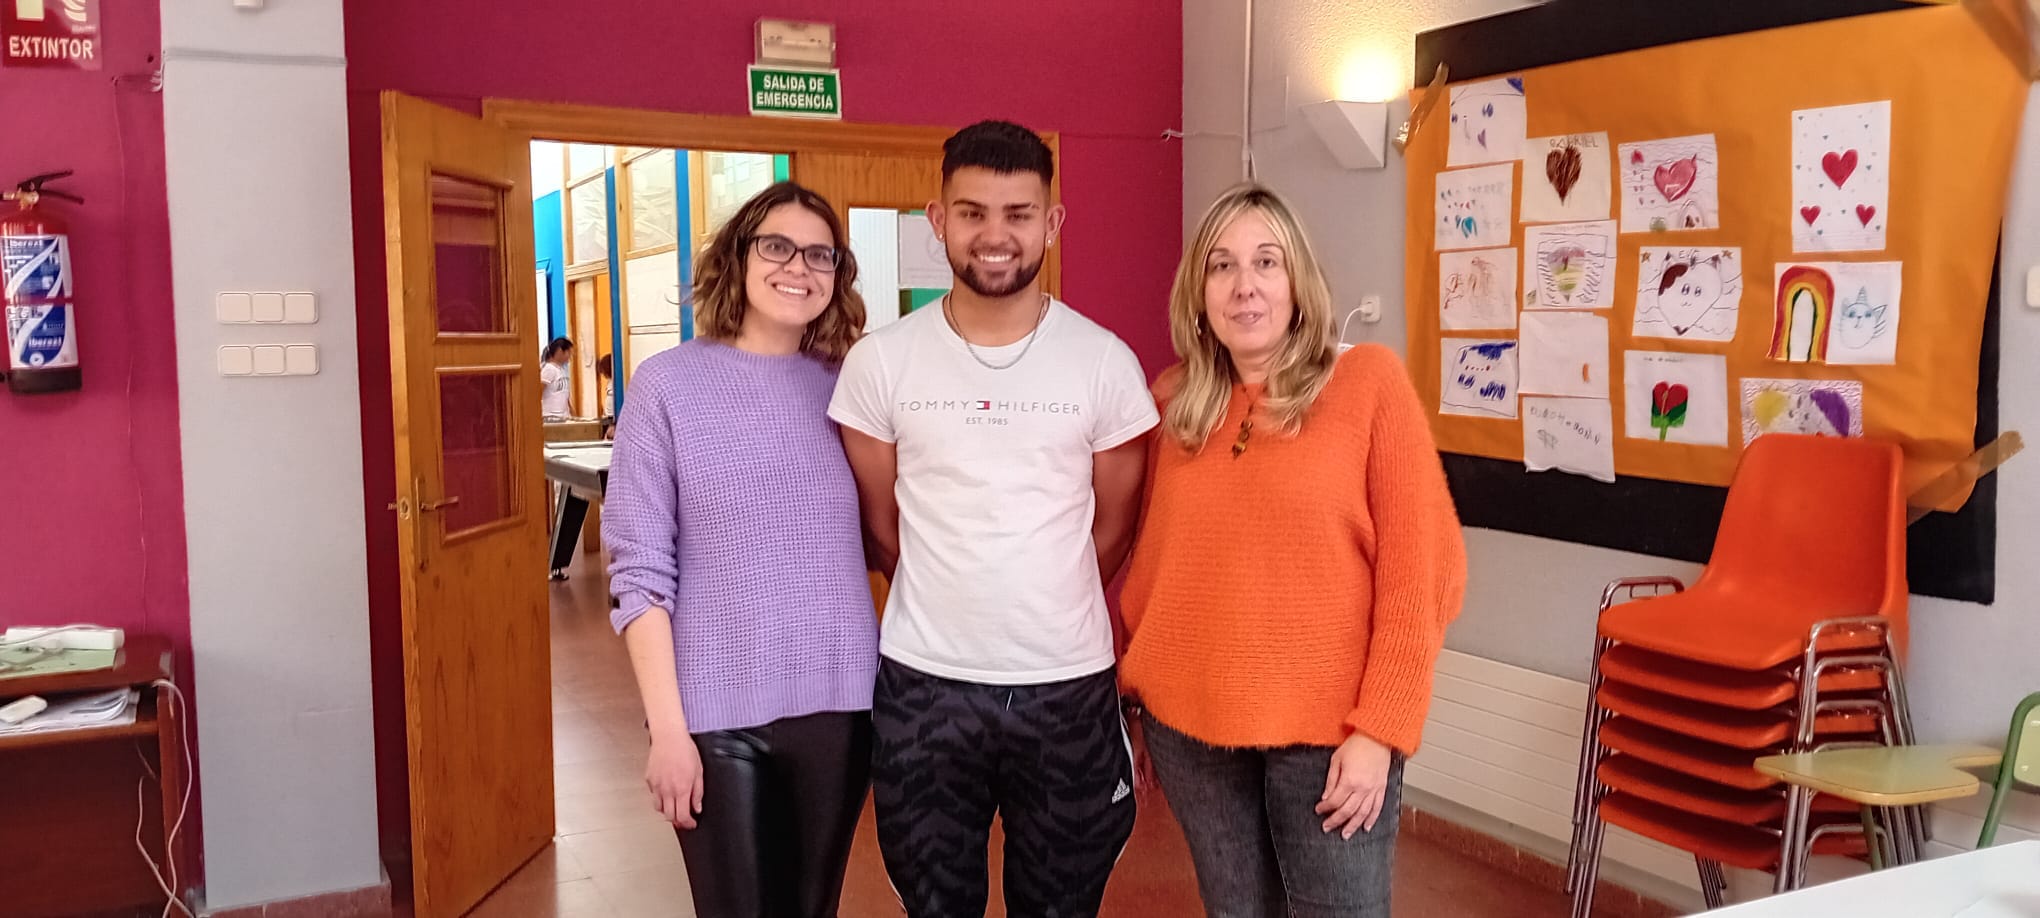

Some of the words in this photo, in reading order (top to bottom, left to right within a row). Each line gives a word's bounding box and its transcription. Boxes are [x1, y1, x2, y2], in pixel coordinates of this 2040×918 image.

[9, 35, 94, 59] EXTINTOR
[763, 75, 806, 92] SALIDA
[809, 77, 825, 92] DE
[756, 92, 834, 110] EMERGENCIA
[899, 401, 969, 412] TOMMY
[998, 401, 1081, 416] HILFIGER
[988, 417, 1008, 426] 1985
